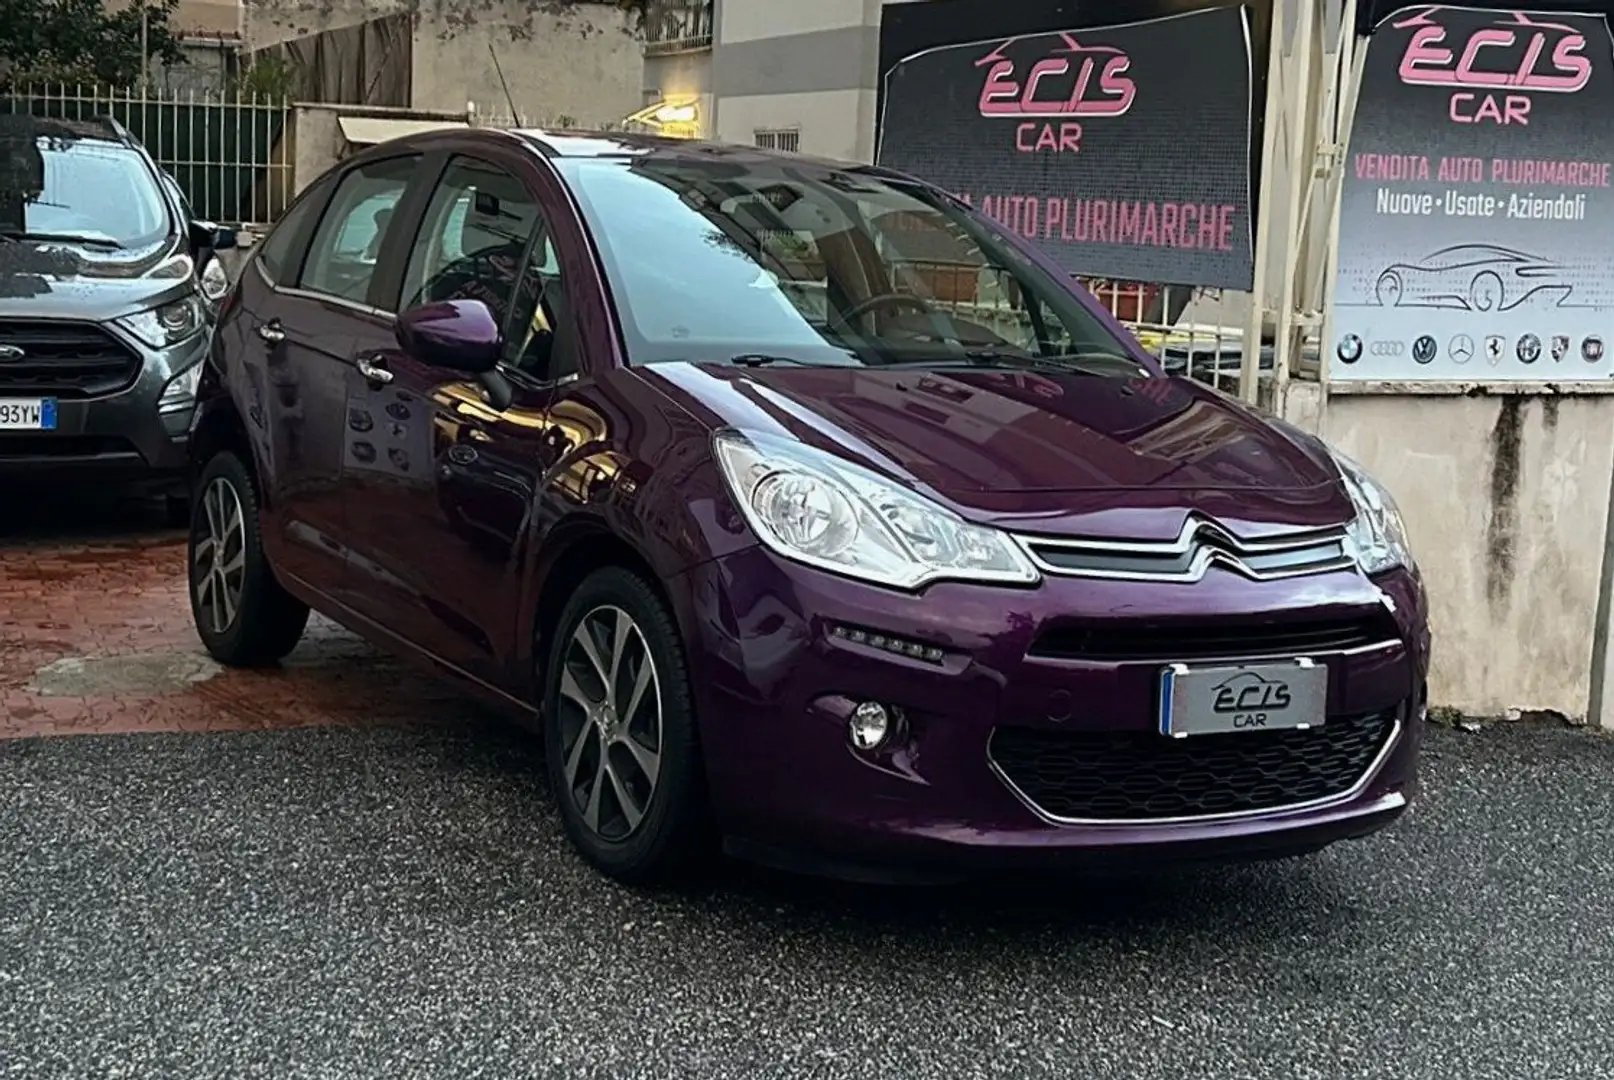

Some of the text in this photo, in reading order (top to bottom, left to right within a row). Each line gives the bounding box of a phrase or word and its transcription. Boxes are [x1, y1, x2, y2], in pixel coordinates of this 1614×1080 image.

[1399, 26, 1592, 92] ECIS
[978, 55, 1136, 117] ECIS
[1450, 93, 1531, 124] CAR
[1015, 122, 1082, 152] CAR
[1355, 154, 1611, 187] VENDITA AUTO PLURIMARCHE
[1376, 188, 1586, 220] Nuove Usate Aziendali
[982, 193, 1038, 239] AUTO
[1046, 197, 1235, 251] PLURIMARCHE
[0, 404, 40, 424] 93YW
[1213, 684, 1291, 712] ECIS
[1233, 713, 1267, 728] CAR
